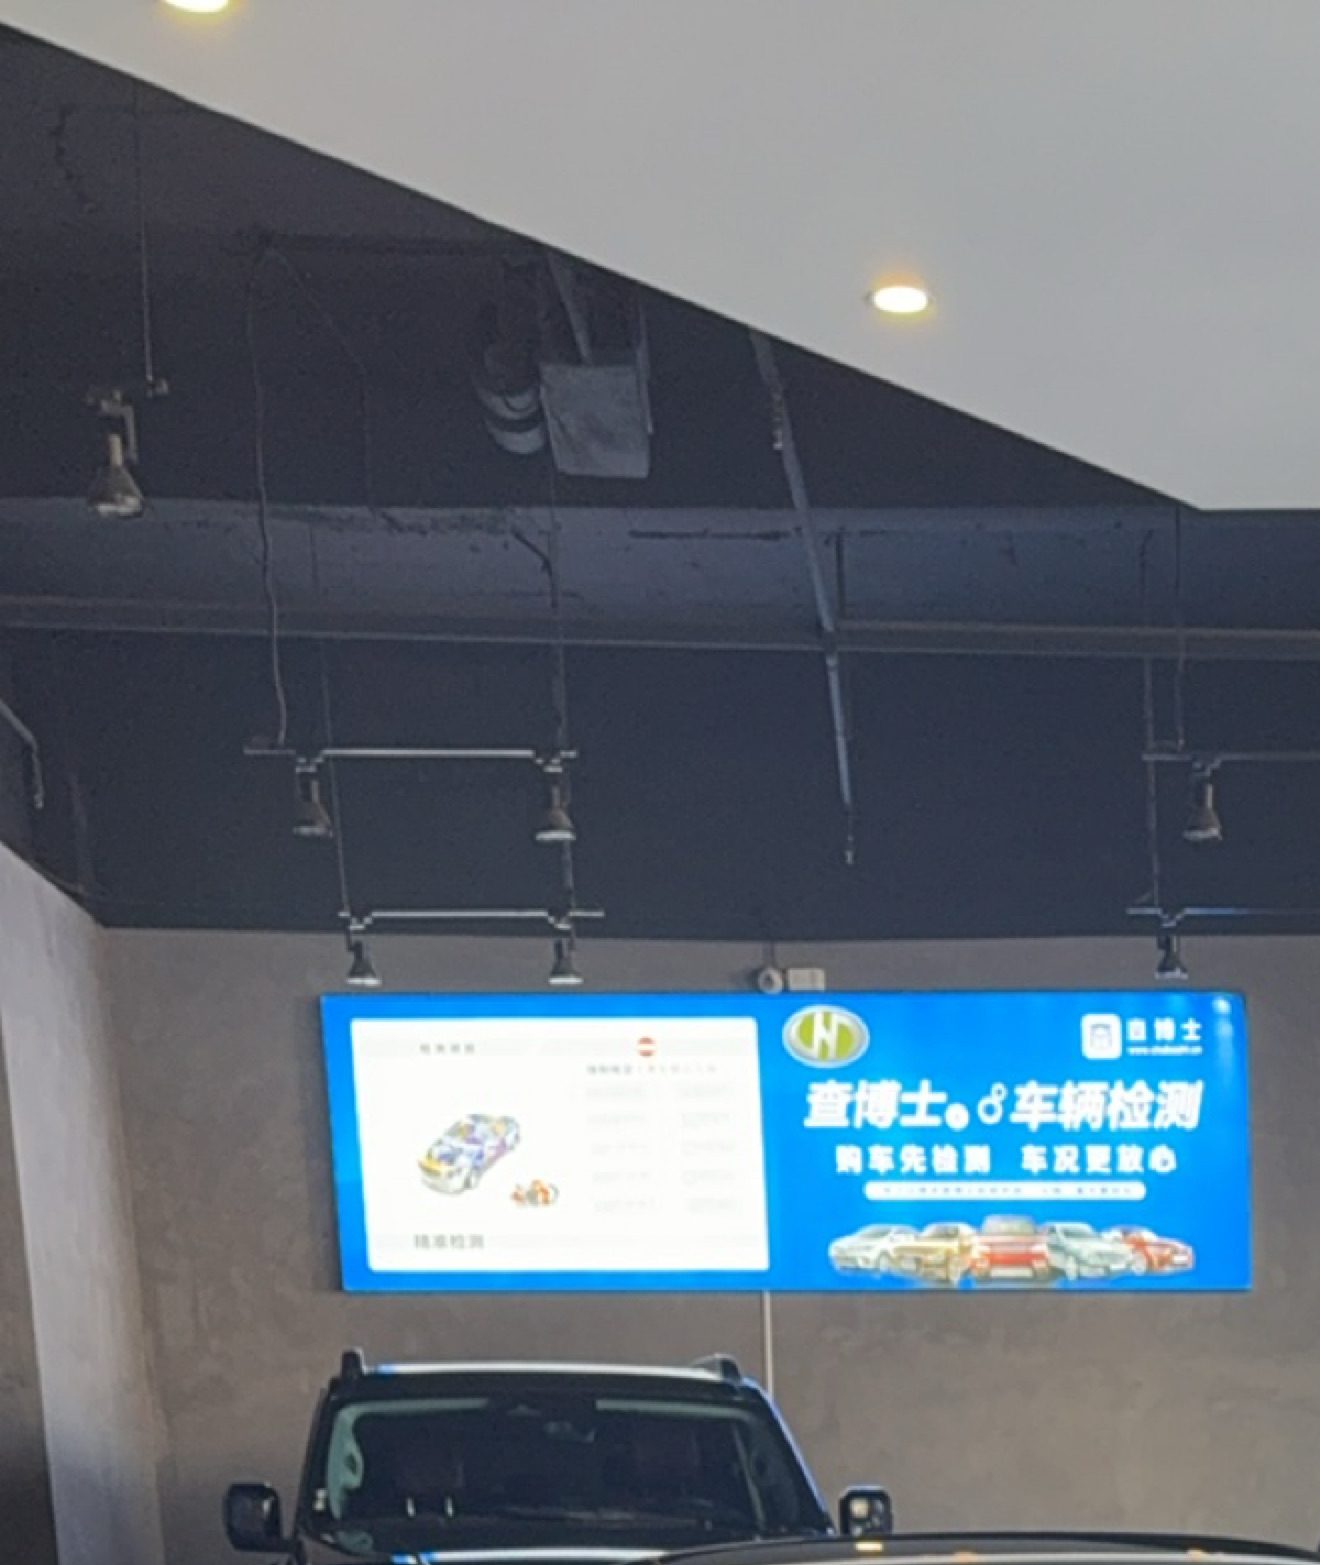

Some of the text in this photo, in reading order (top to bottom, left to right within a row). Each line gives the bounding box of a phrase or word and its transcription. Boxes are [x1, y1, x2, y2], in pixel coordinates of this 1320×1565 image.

[803, 1077, 1205, 1133] 查博士 车辆检测
[835, 1143, 1177, 1175] 购车先检测 车况更放心
